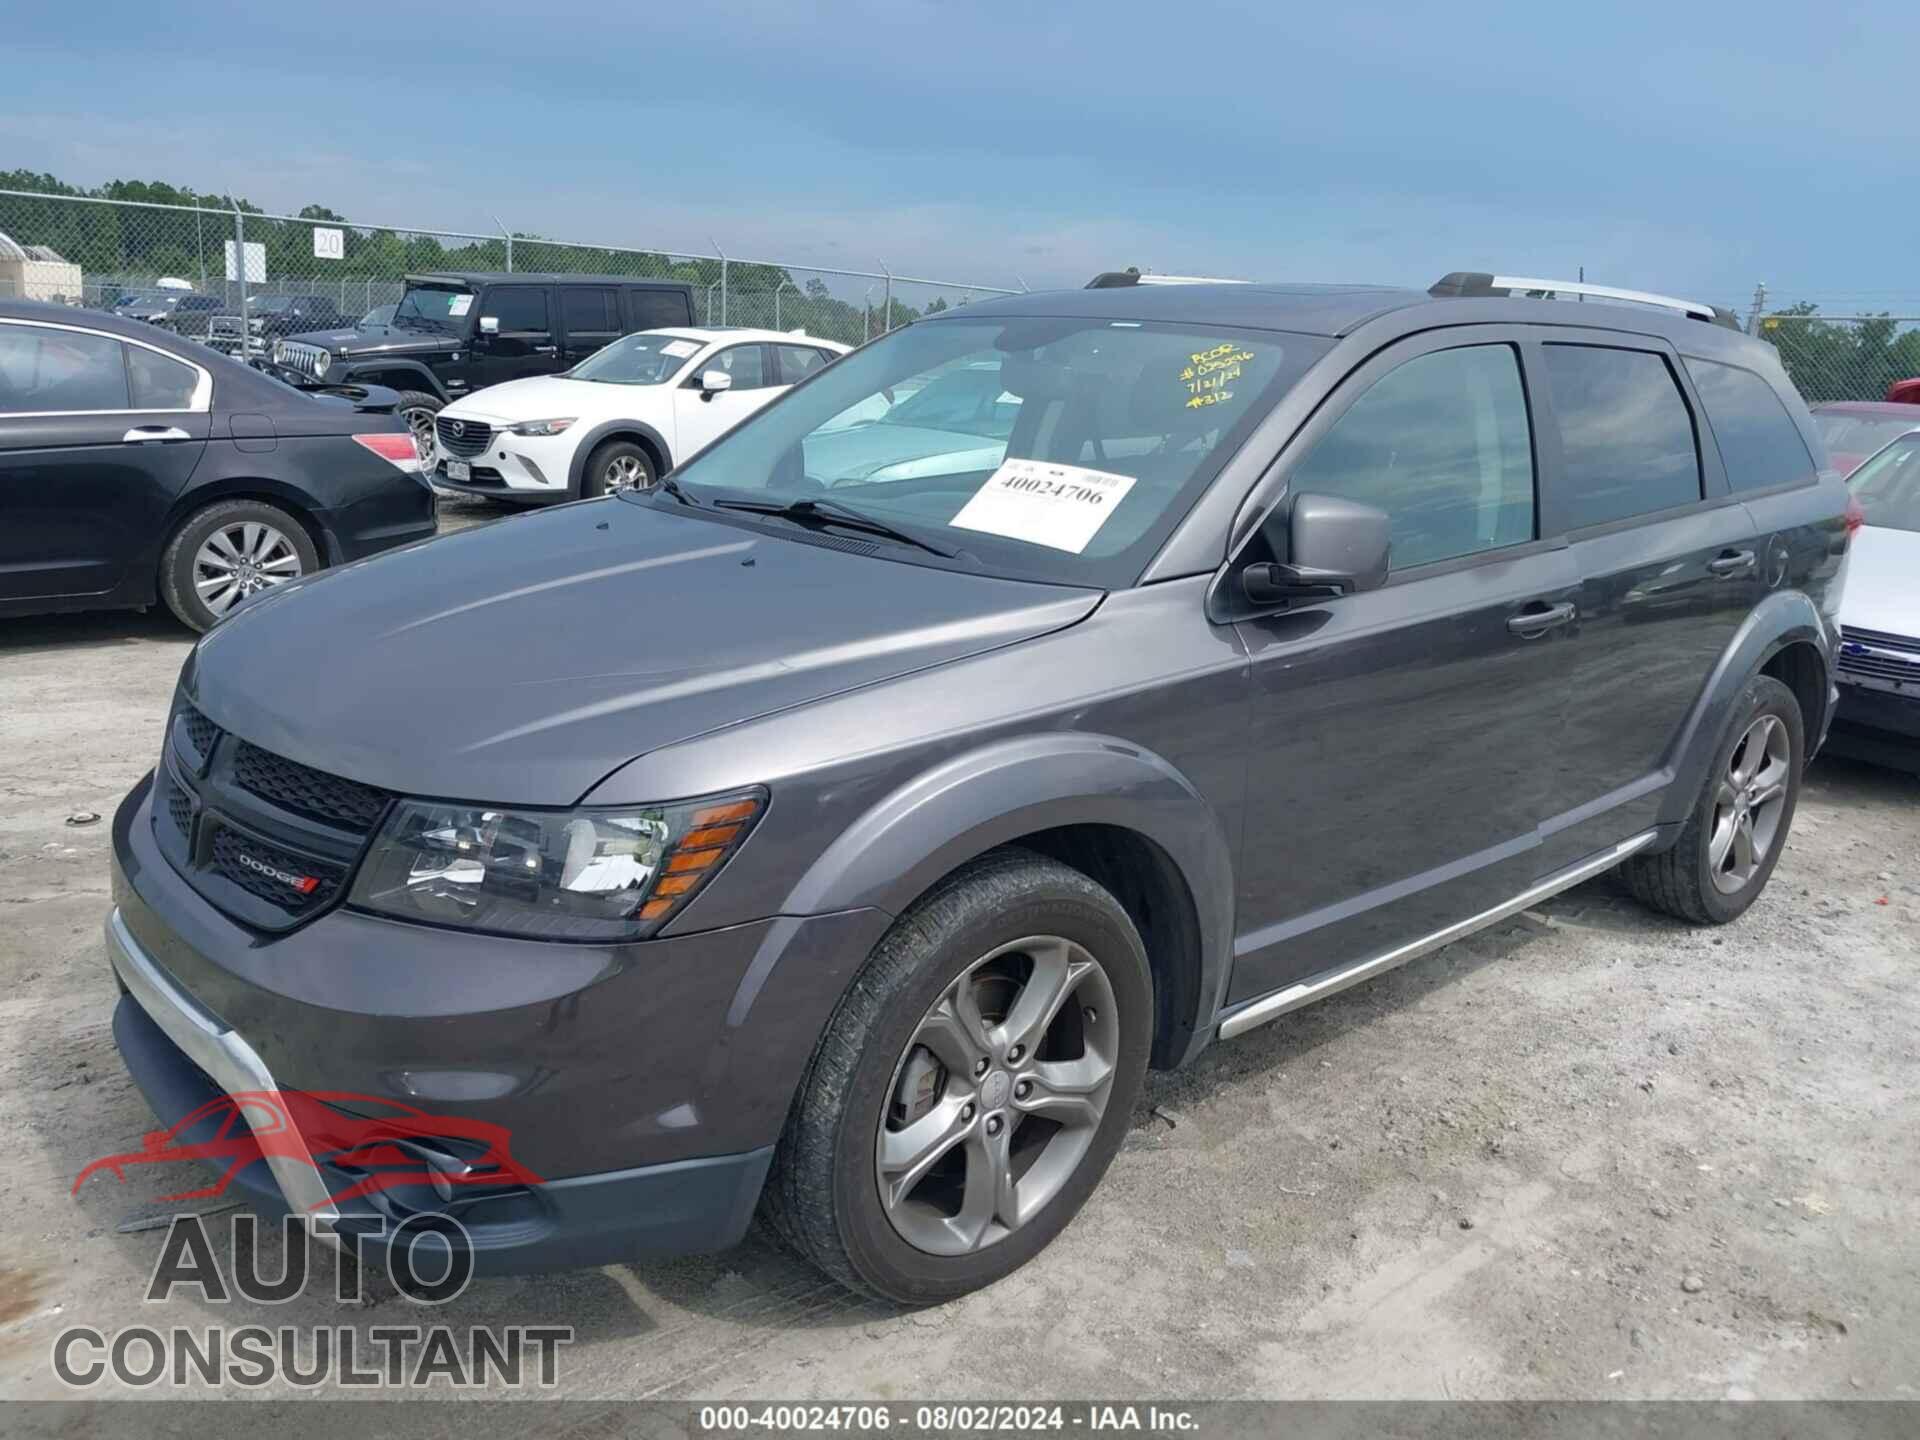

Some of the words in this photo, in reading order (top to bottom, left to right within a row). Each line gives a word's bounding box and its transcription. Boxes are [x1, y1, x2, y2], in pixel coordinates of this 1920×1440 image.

[319, 233, 341, 254] 20
[1001, 475, 1104, 505] 40024706
[239, 854, 306, 890] DODGE
